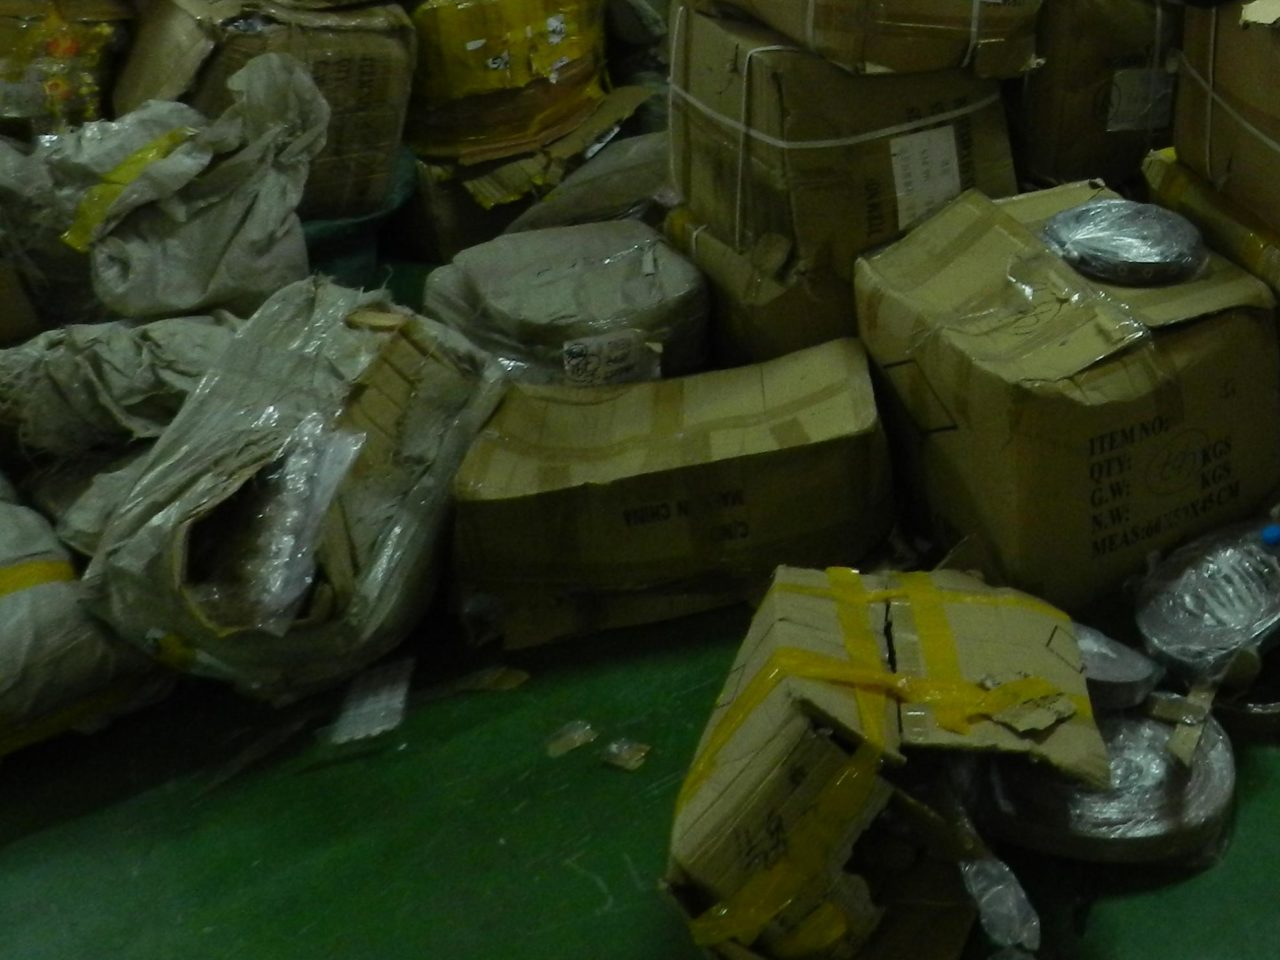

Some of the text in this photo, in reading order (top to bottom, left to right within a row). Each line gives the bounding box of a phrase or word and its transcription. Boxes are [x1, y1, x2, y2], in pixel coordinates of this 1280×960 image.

[1088, 428, 1135, 457] ITEM
[1200, 436, 1233, 467] KGS
[1090, 463, 1232, 508] G.W: KGS
